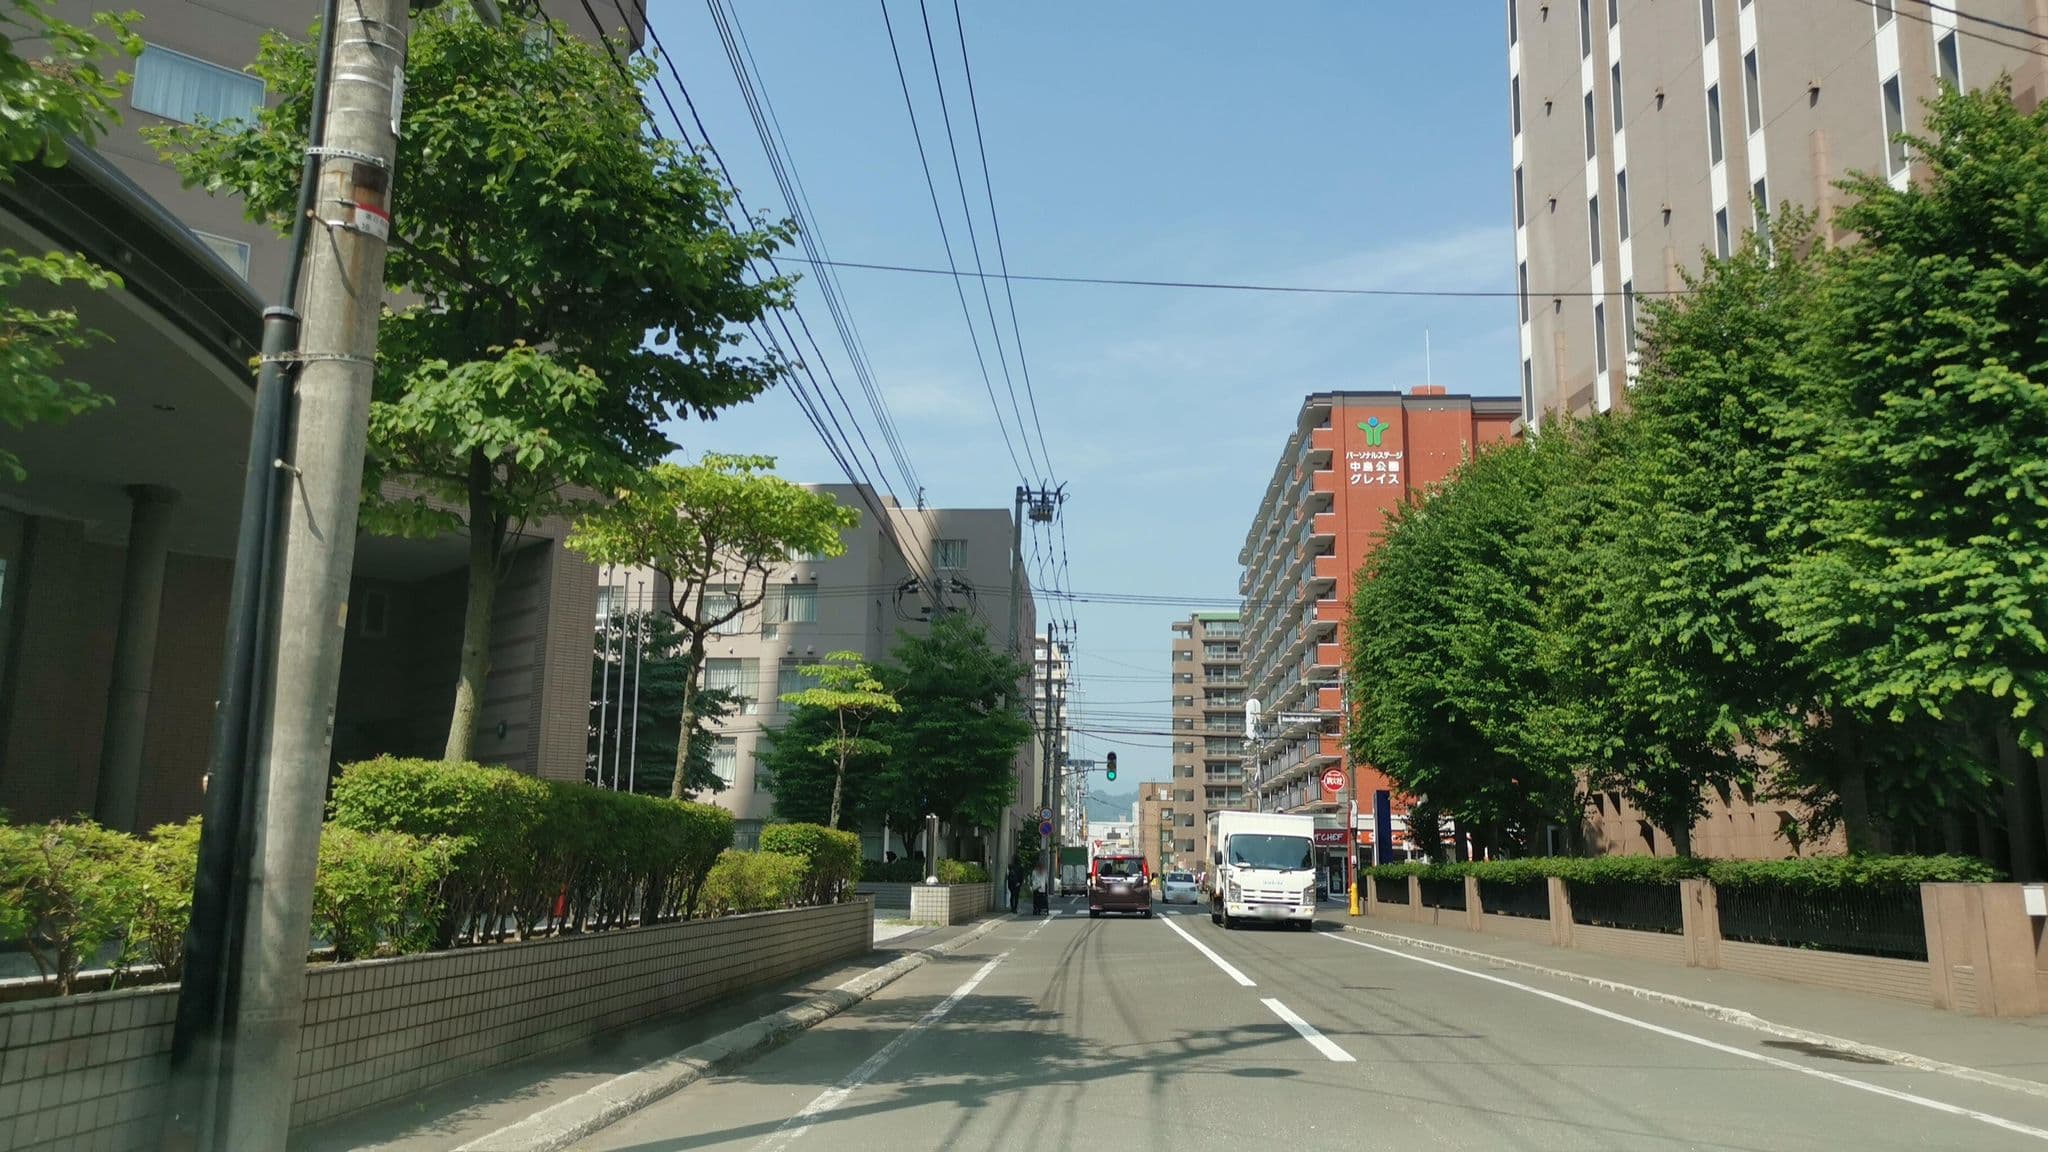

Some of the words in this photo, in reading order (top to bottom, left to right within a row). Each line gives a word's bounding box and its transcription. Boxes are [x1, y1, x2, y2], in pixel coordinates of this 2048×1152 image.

[1346, 451, 1403, 460] パーソナルステージ
[1350, 473, 1400, 484] グレイス
